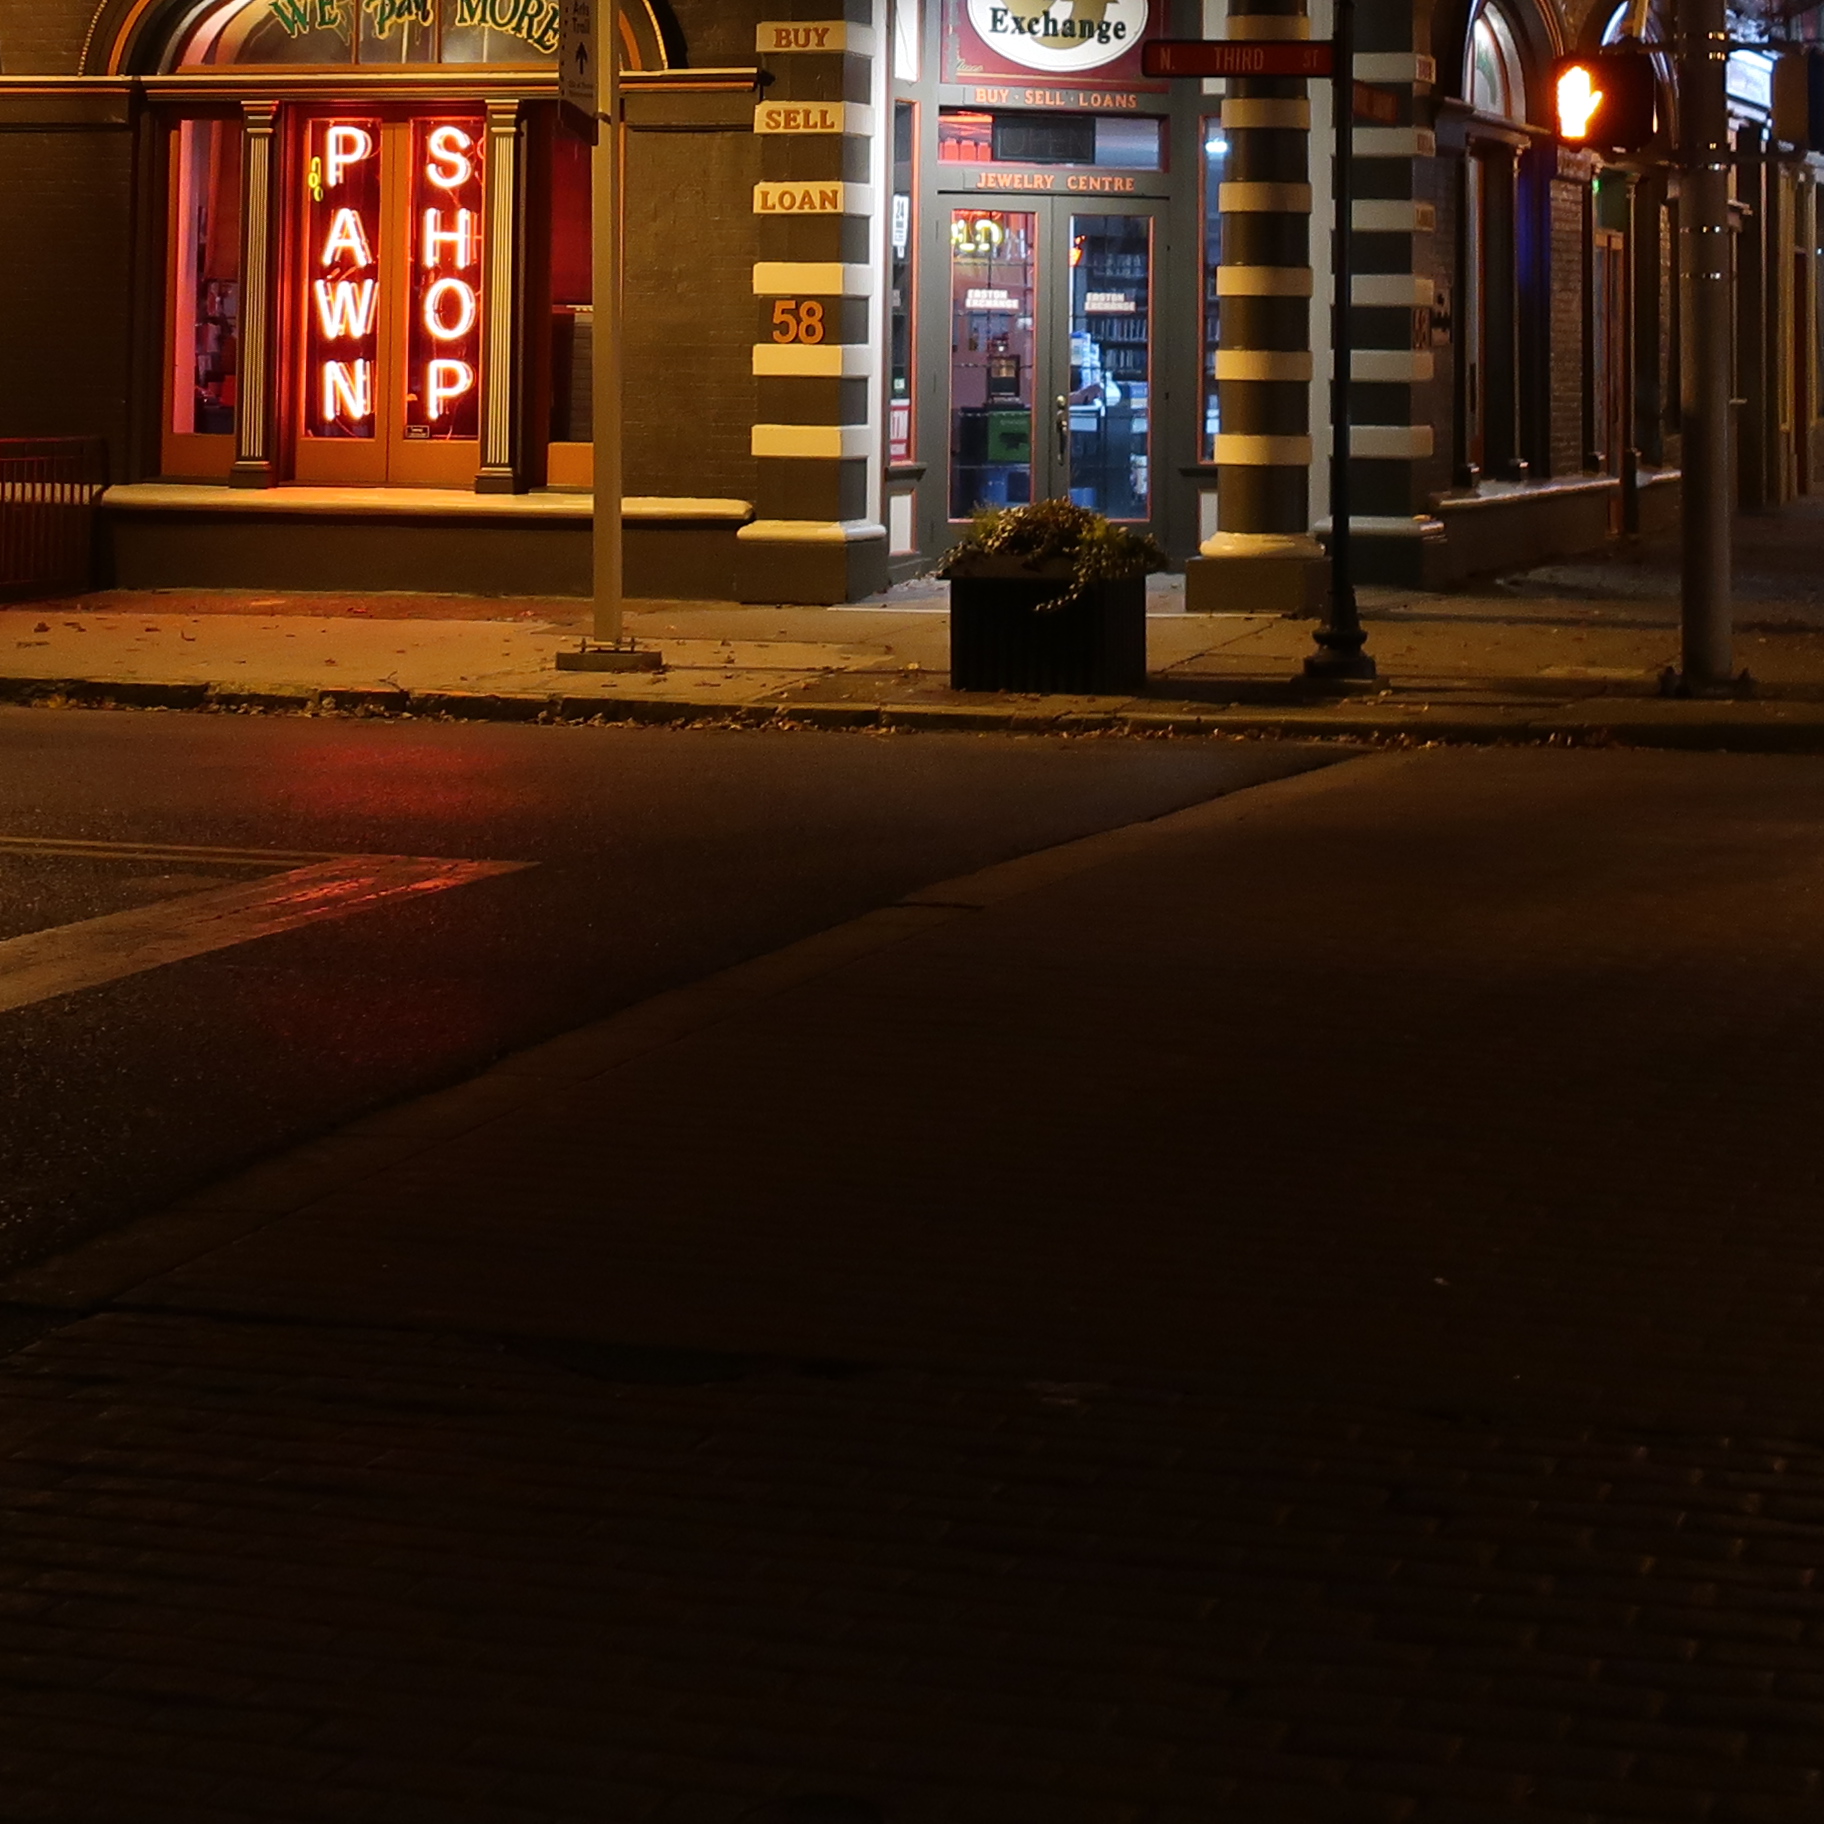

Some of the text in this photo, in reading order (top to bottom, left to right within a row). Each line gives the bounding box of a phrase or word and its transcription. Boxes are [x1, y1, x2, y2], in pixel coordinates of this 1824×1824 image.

[989, 7, 1127, 45] Exchange
[774, 27, 830, 49] BUY
[1160, 47, 1319, 72] N. THIRD ST
[975, 88, 1140, 109] BUY SELL LOANS
[765, 109, 835, 130] SELL
[977, 173, 1136, 192] JEWELRY CENTRE
[761, 190, 839, 211] LOAN
[314, 125, 380, 422] PAWN
[423, 125, 479, 422] SHOP
[772, 299, 826, 344] 58
